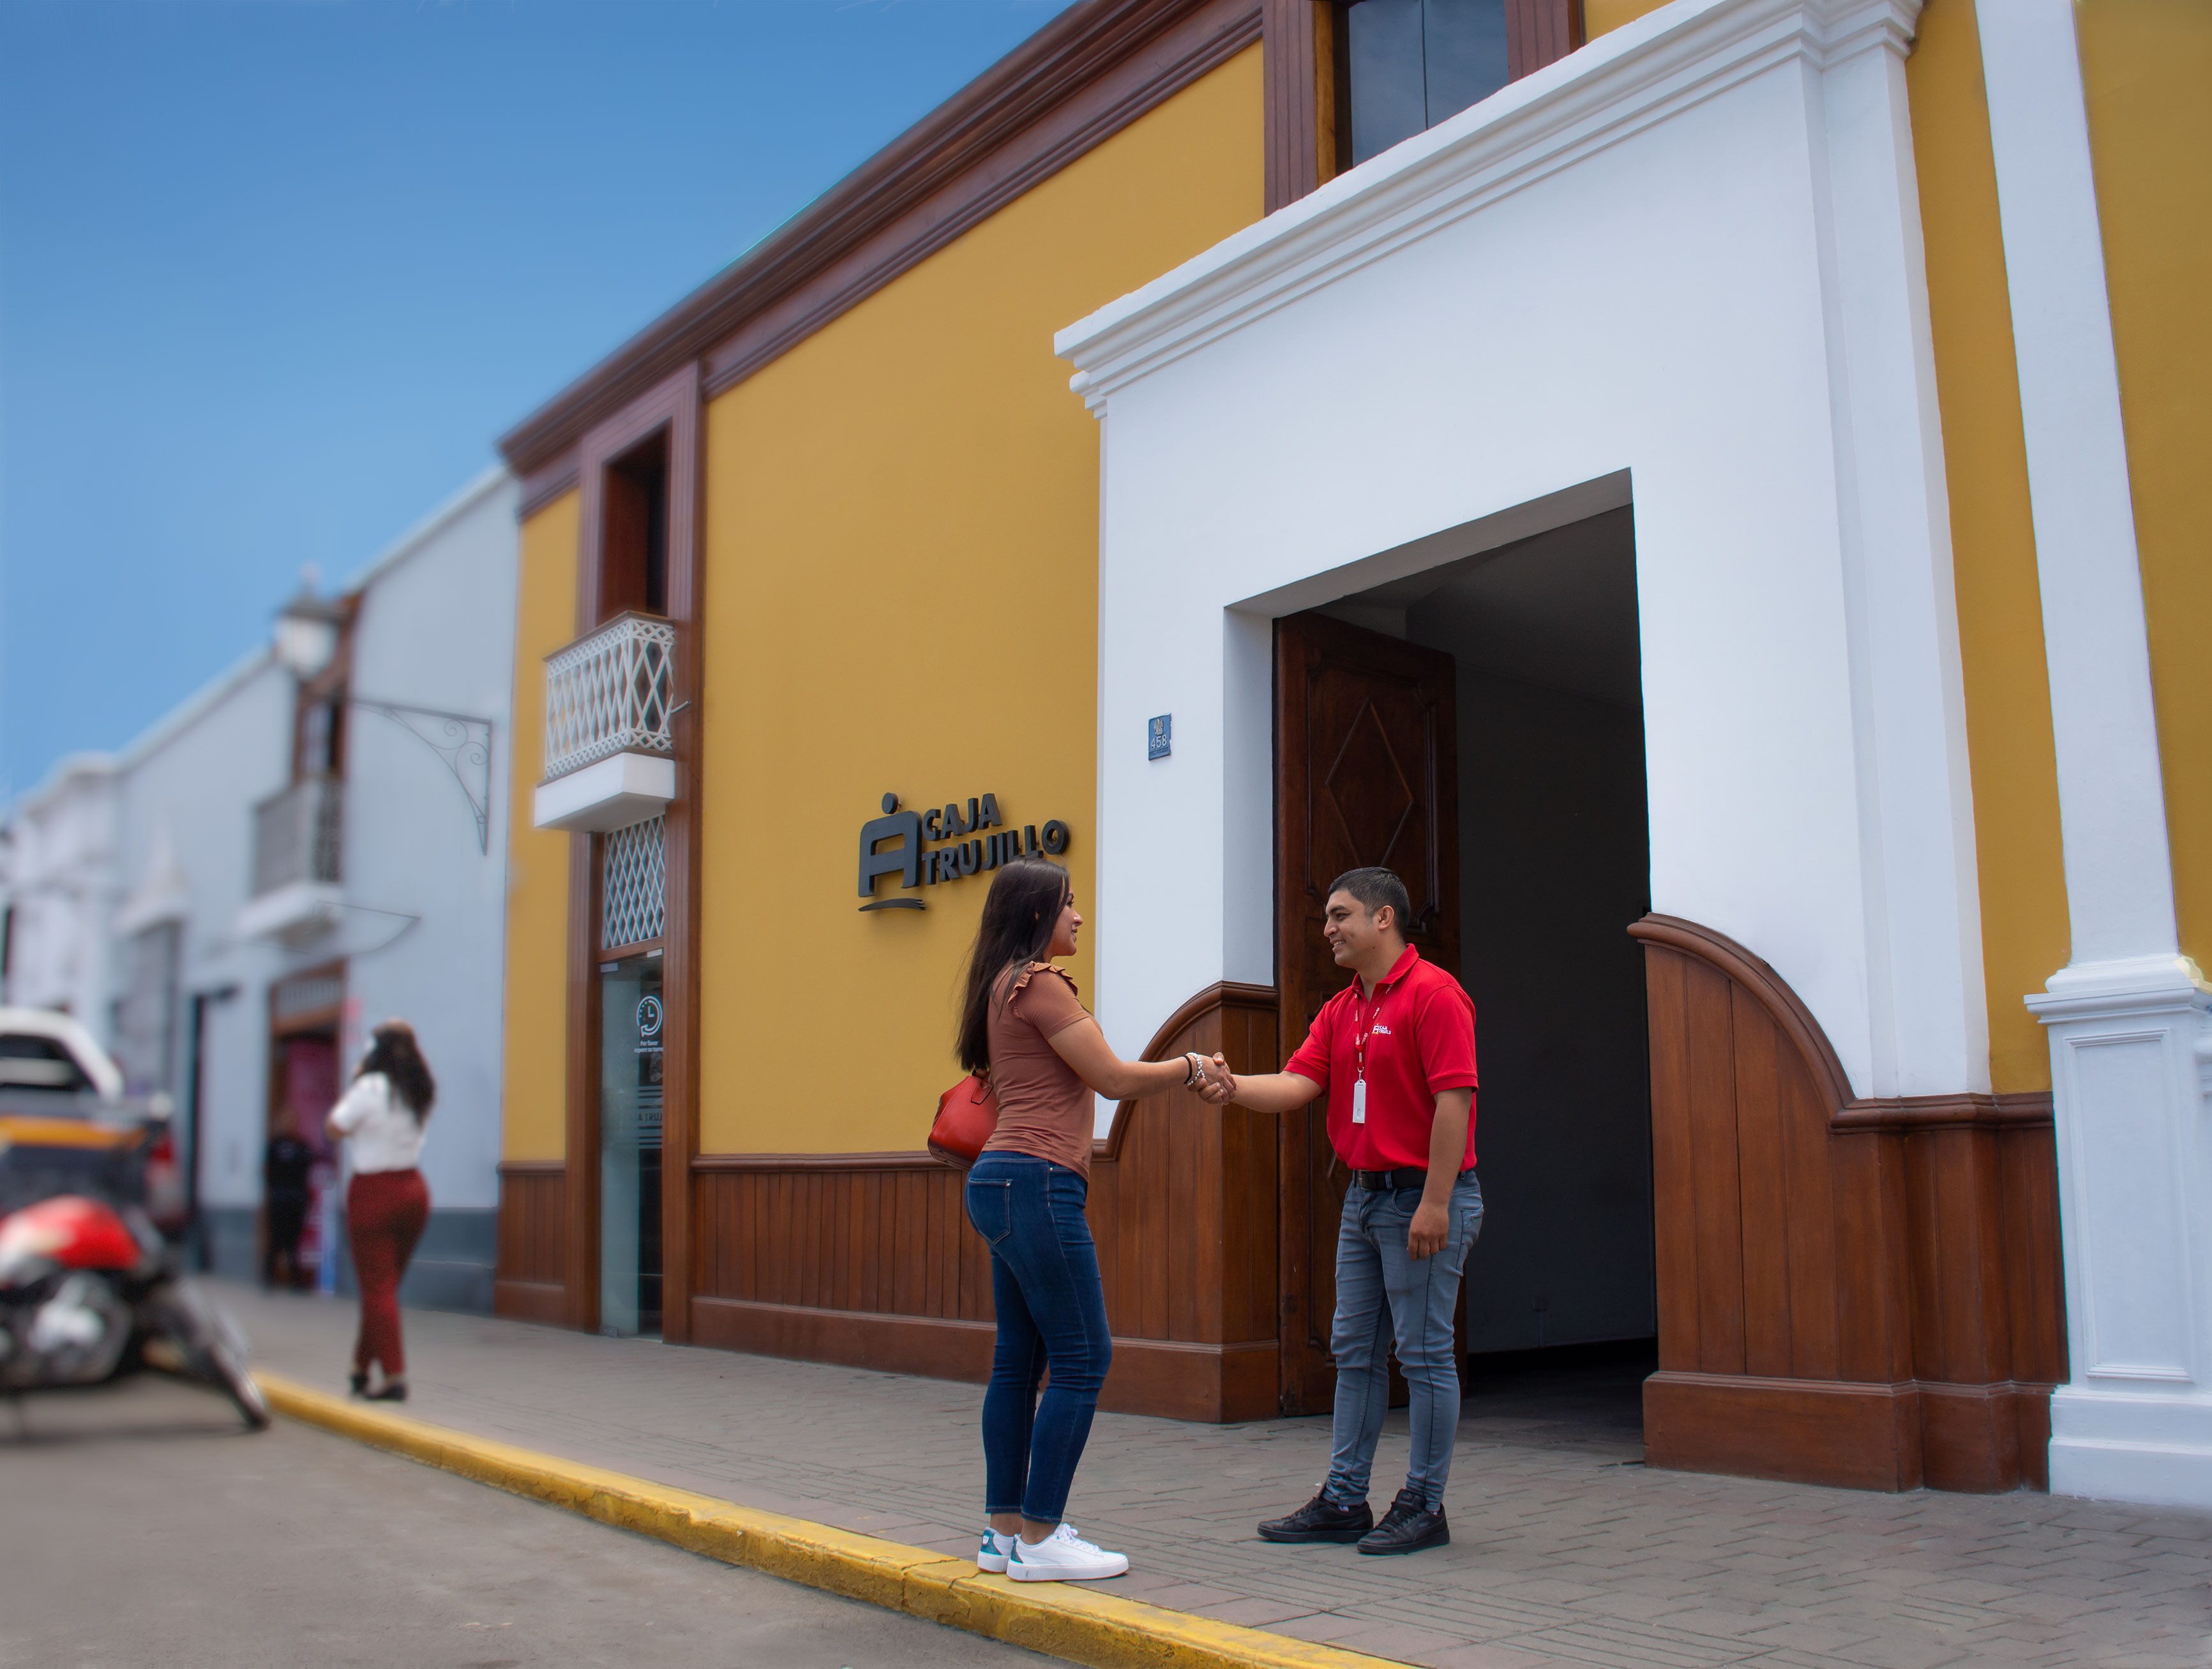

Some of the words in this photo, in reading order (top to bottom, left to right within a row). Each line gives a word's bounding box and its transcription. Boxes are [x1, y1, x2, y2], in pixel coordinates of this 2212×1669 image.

[1151, 734, 1167, 749] 458
[922, 793, 1003, 841] CAJA
[922, 820, 1069, 885] TRUJILLO
